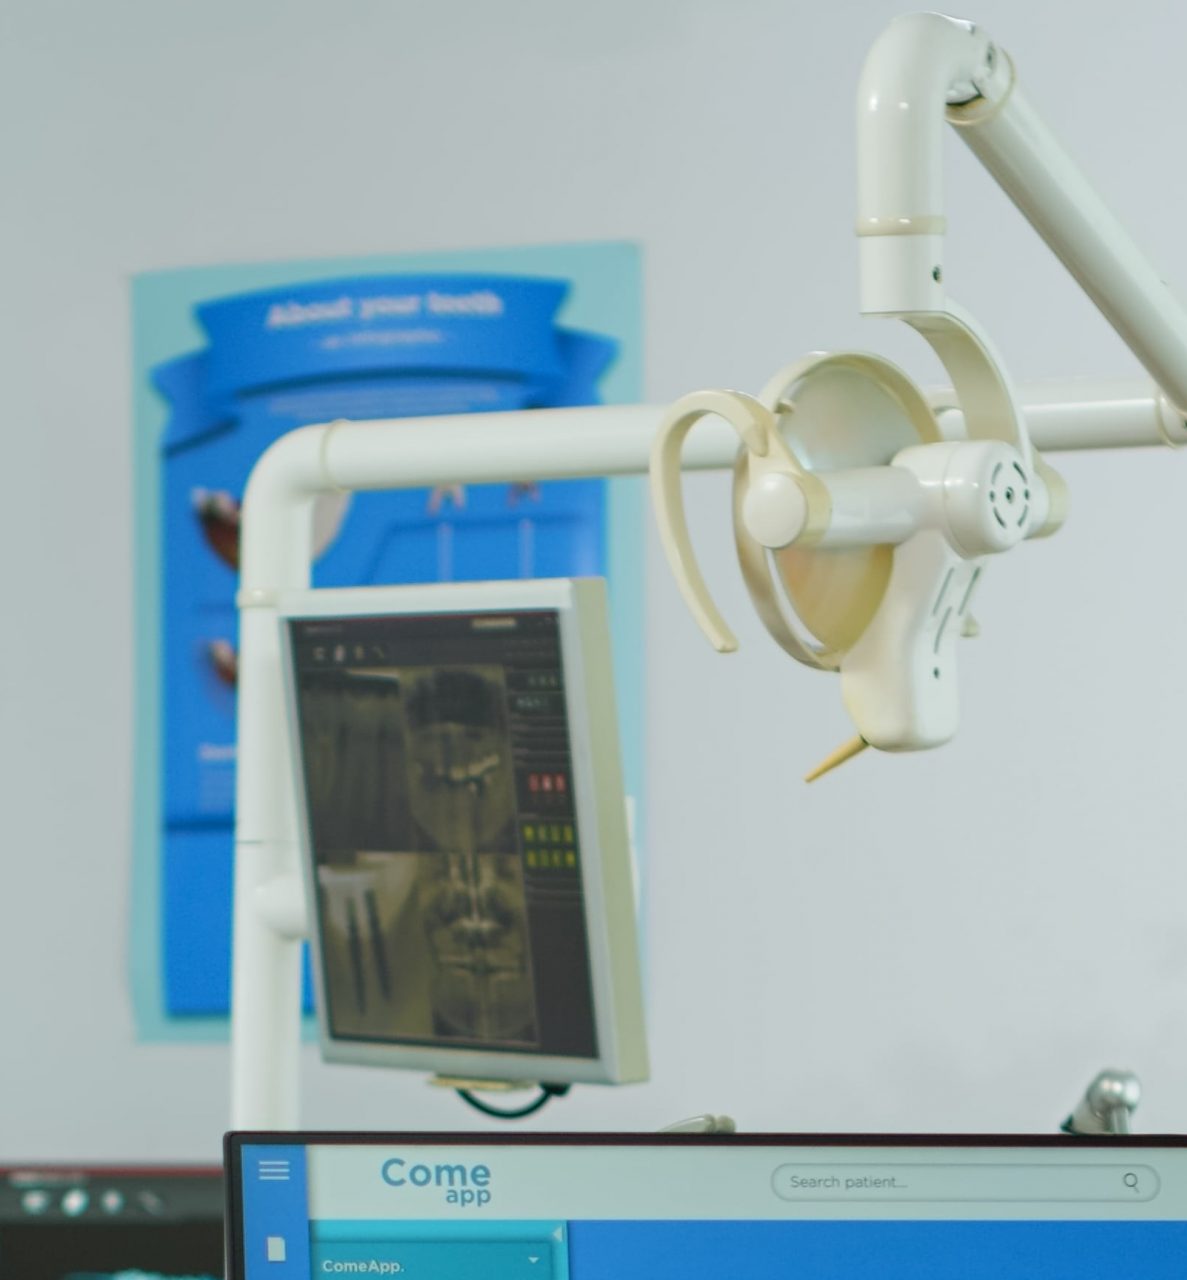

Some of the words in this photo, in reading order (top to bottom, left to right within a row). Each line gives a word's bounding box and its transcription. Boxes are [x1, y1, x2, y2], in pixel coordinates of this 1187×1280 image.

[382, 1158, 491, 1187] Come
[790, 1175, 840, 1189] Search
[446, 1189, 492, 1208] app
[322, 1259, 405, 1275] ComeApp.
